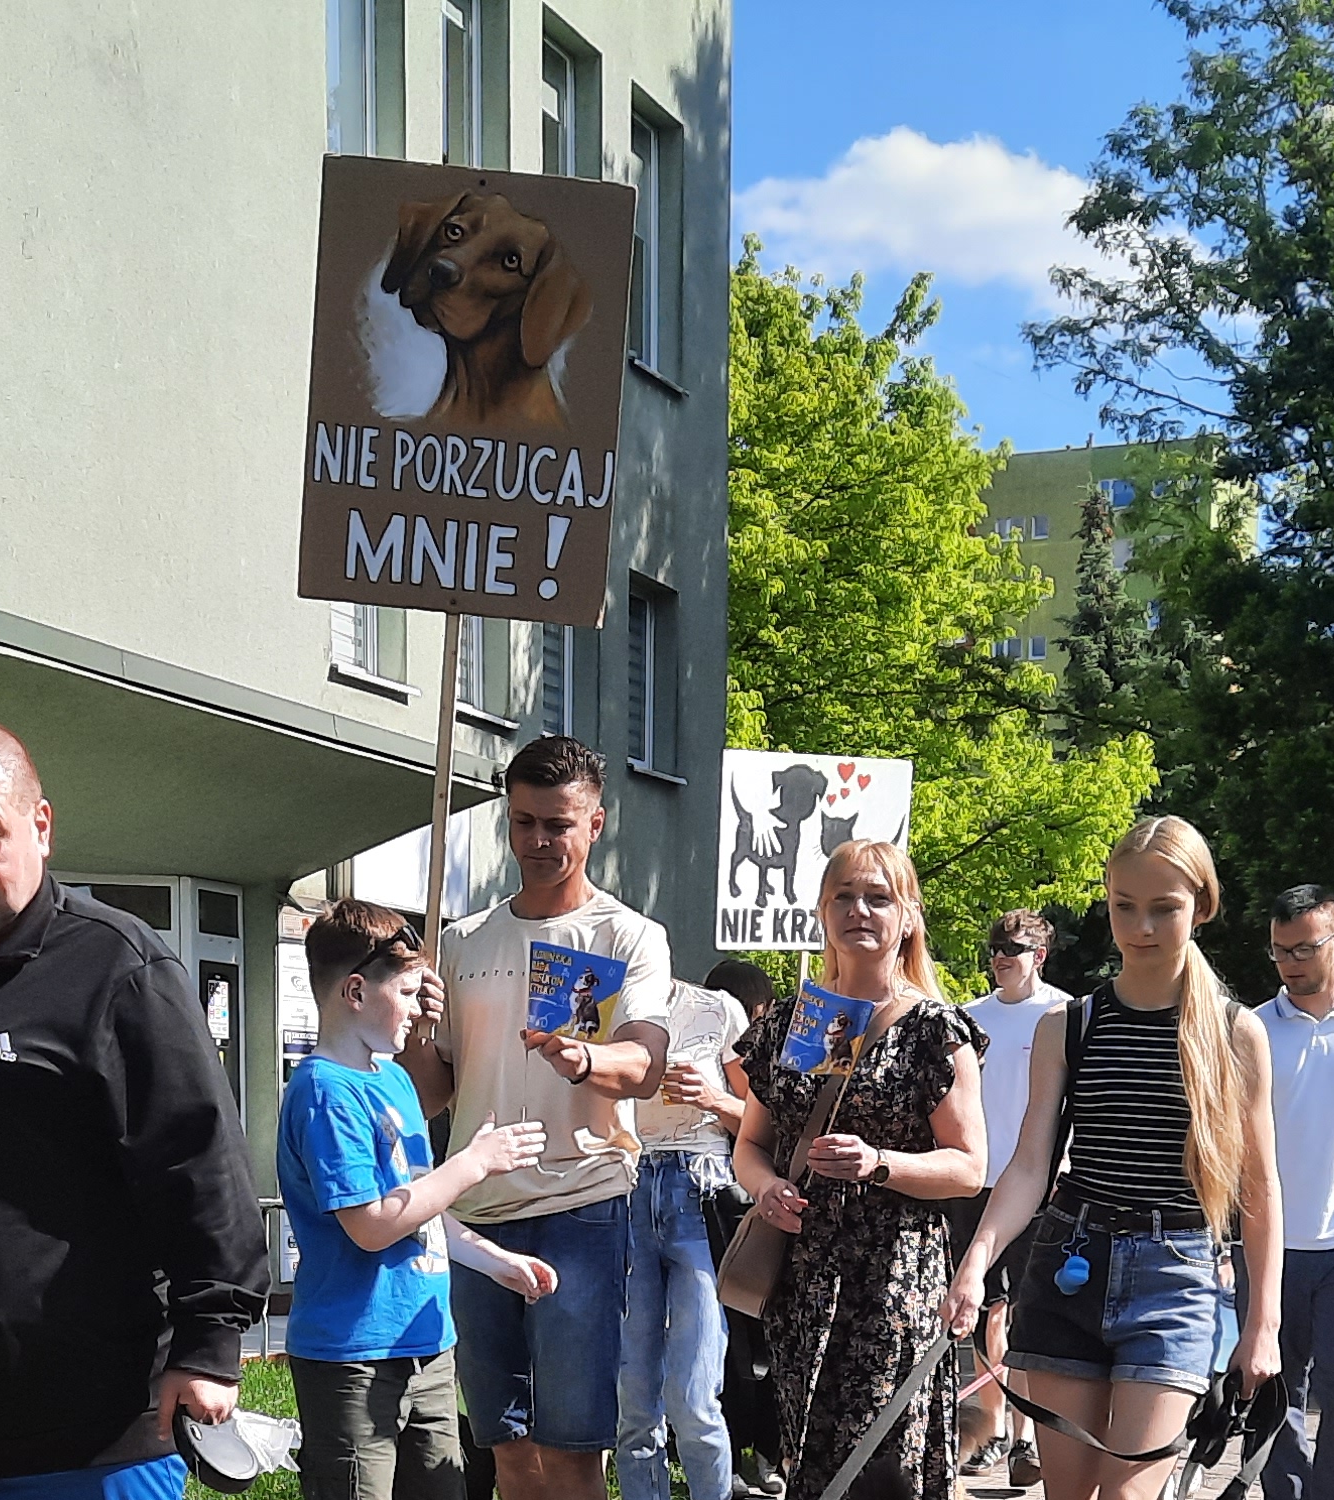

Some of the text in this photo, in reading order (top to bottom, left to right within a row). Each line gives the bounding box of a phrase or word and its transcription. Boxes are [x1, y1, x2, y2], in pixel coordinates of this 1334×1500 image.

[314, 421, 616, 509] NIE PORZUCAJ
[344, 509, 519, 597] MNIE
[720, 907, 765, 944] NIE
